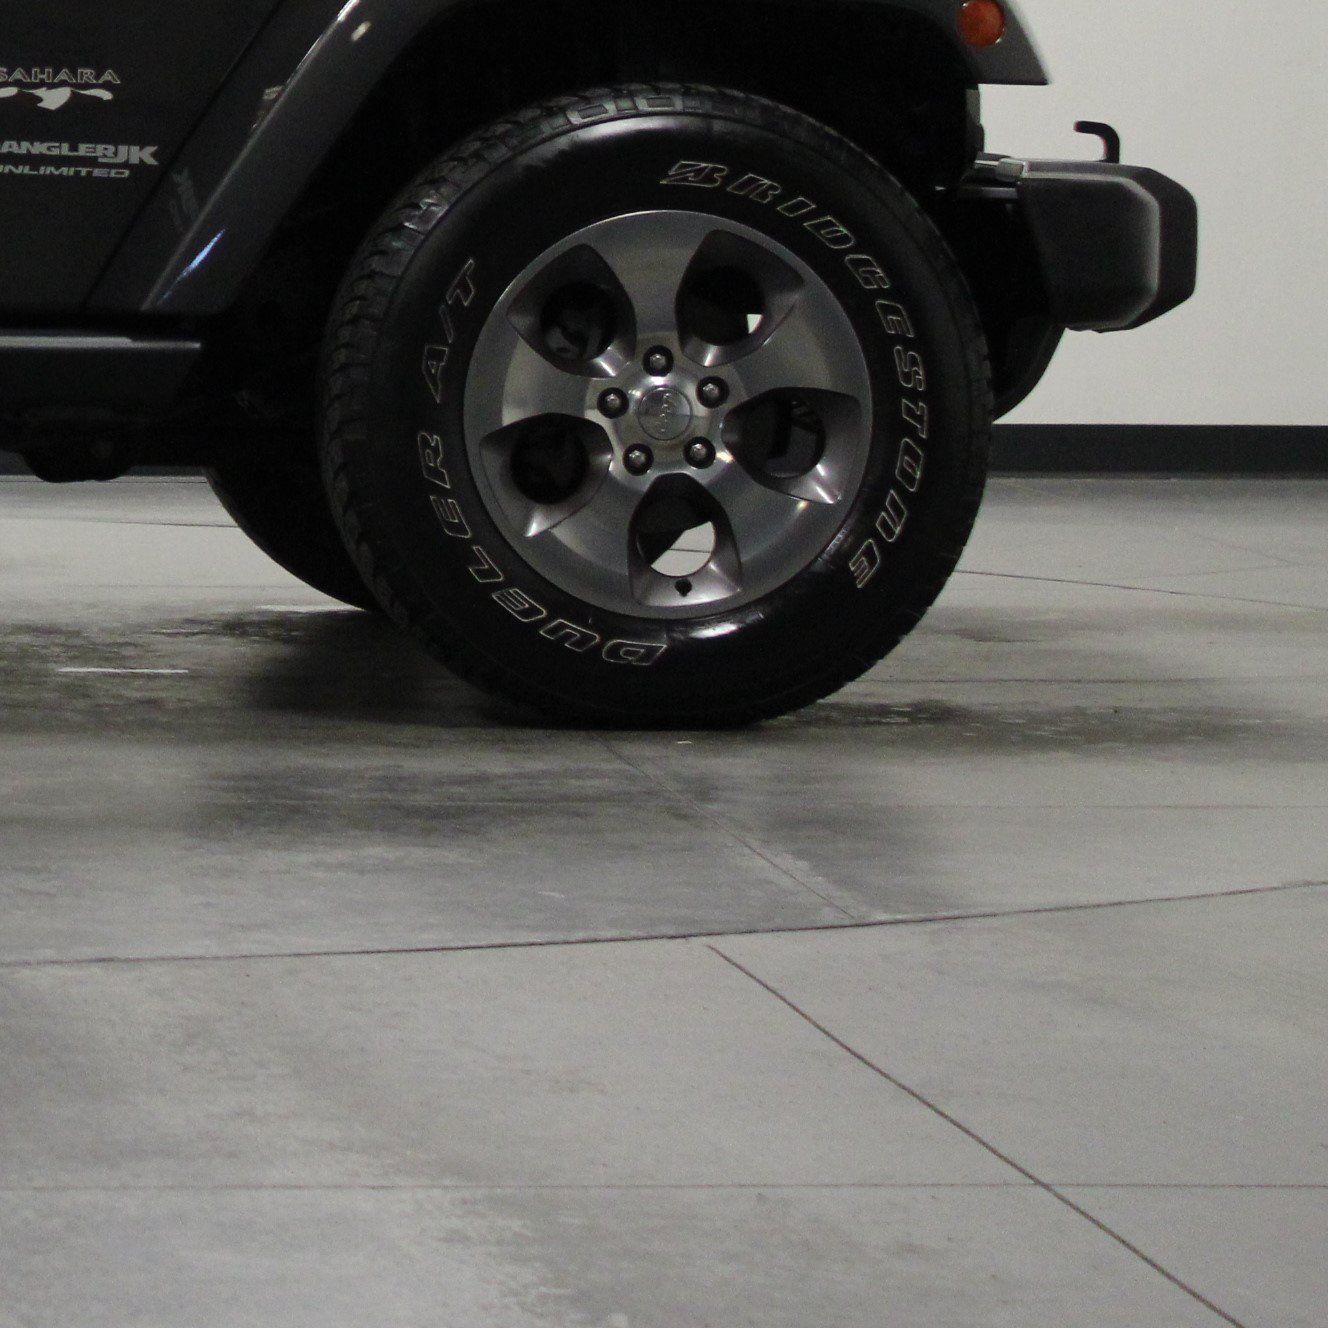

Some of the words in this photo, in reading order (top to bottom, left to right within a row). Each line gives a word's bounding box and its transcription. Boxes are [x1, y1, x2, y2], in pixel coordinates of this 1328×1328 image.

[421, 258, 476, 404] A/T
[659, 160, 929, 587] BRIDGESTONE
[417, 429, 668, 666] DUELER
